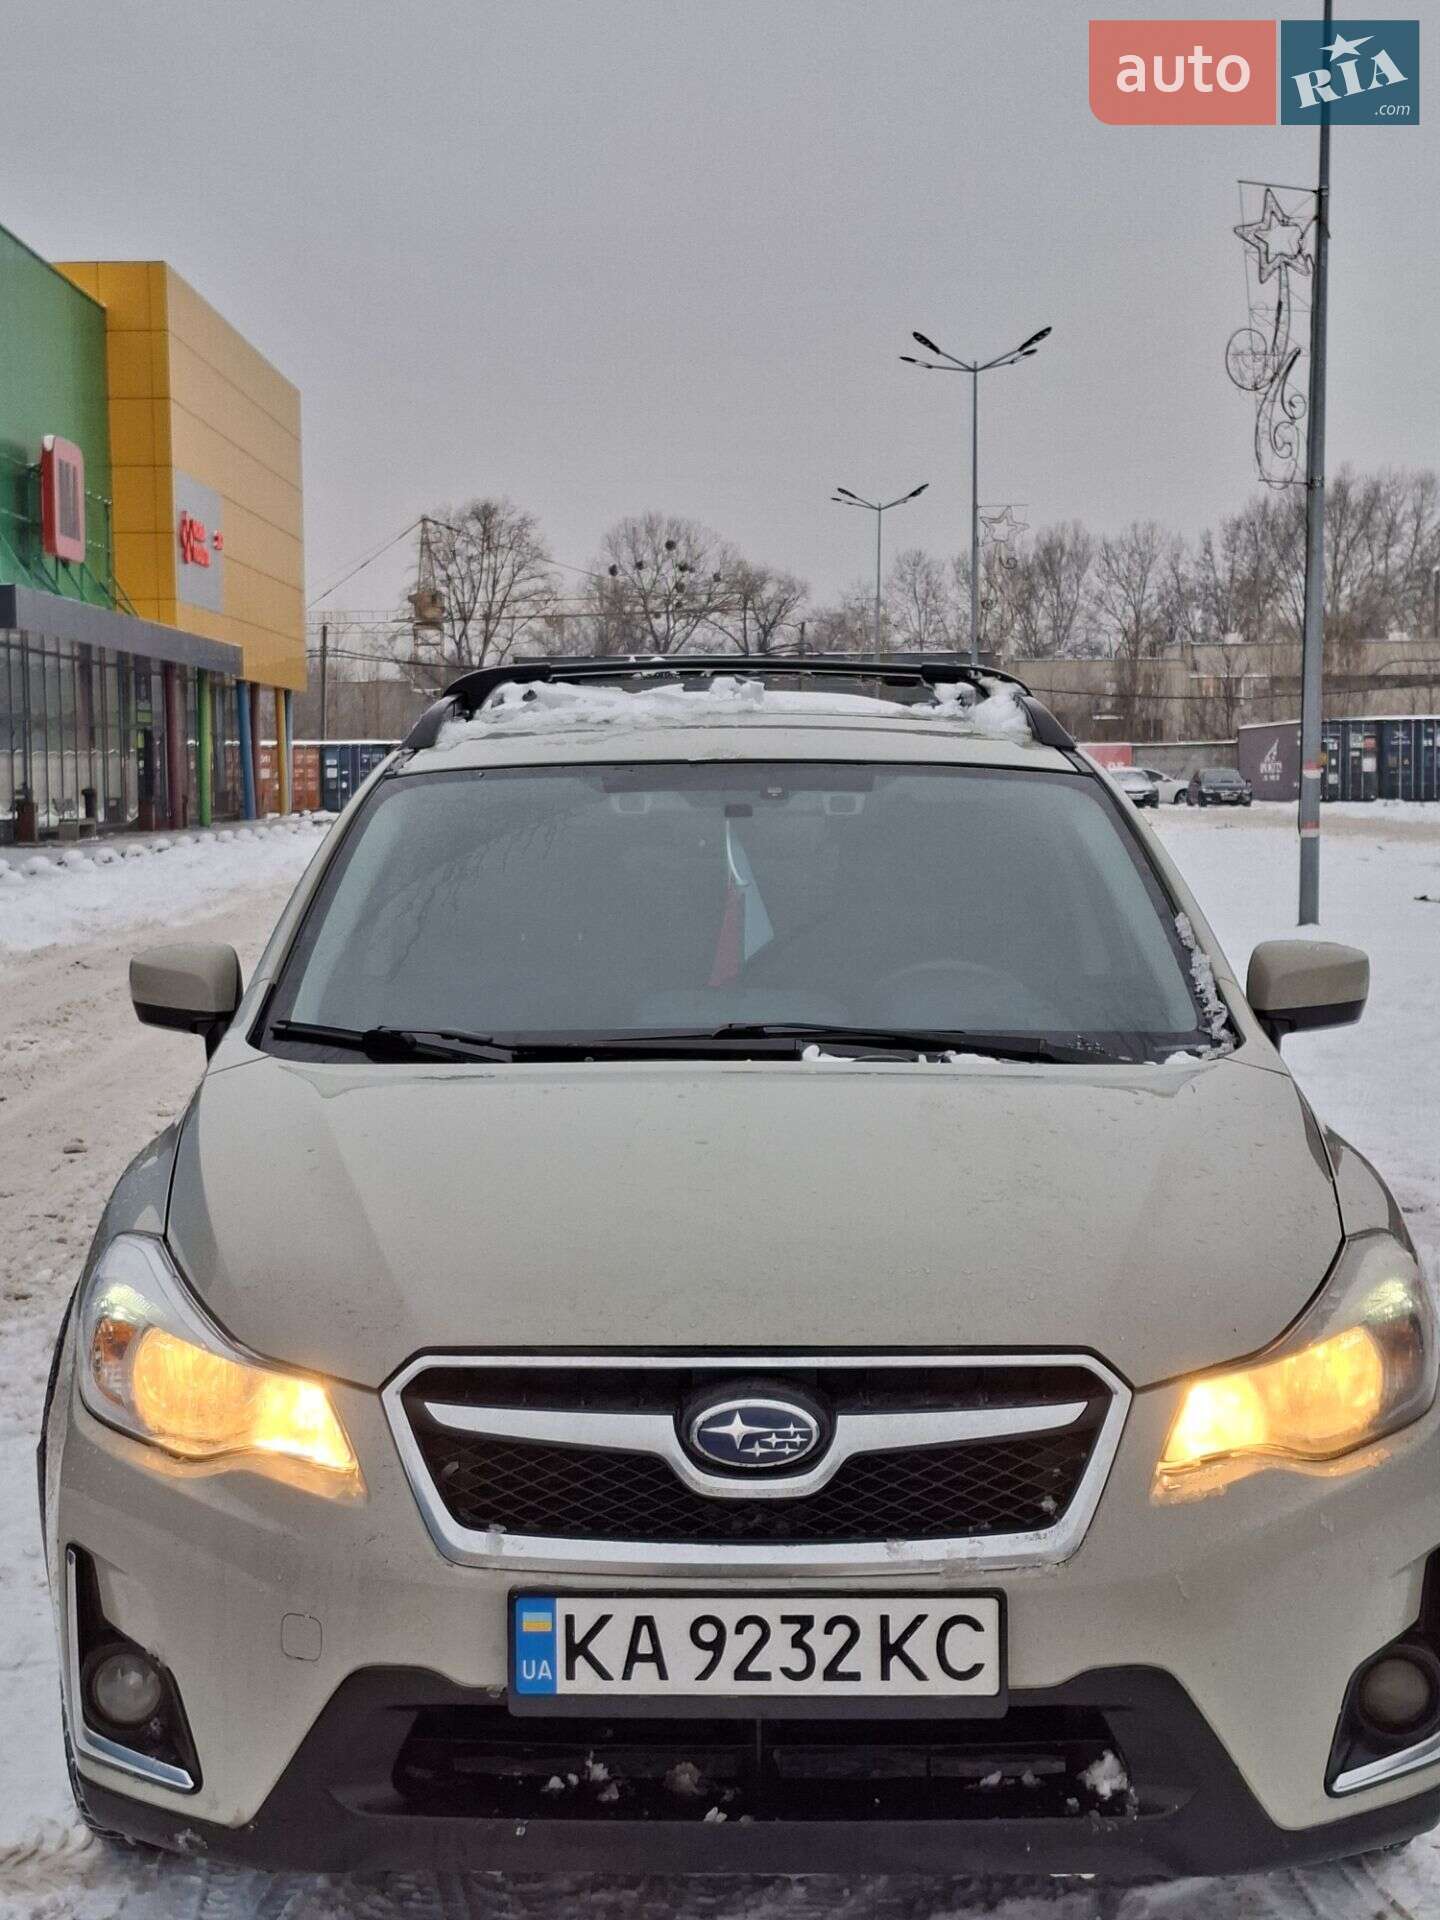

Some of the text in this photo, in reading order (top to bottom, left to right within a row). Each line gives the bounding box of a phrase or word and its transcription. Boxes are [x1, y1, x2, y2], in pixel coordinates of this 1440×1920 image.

[564, 1613, 985, 1682] KA 9232 KC
[522, 1660, 553, 1681] UA
